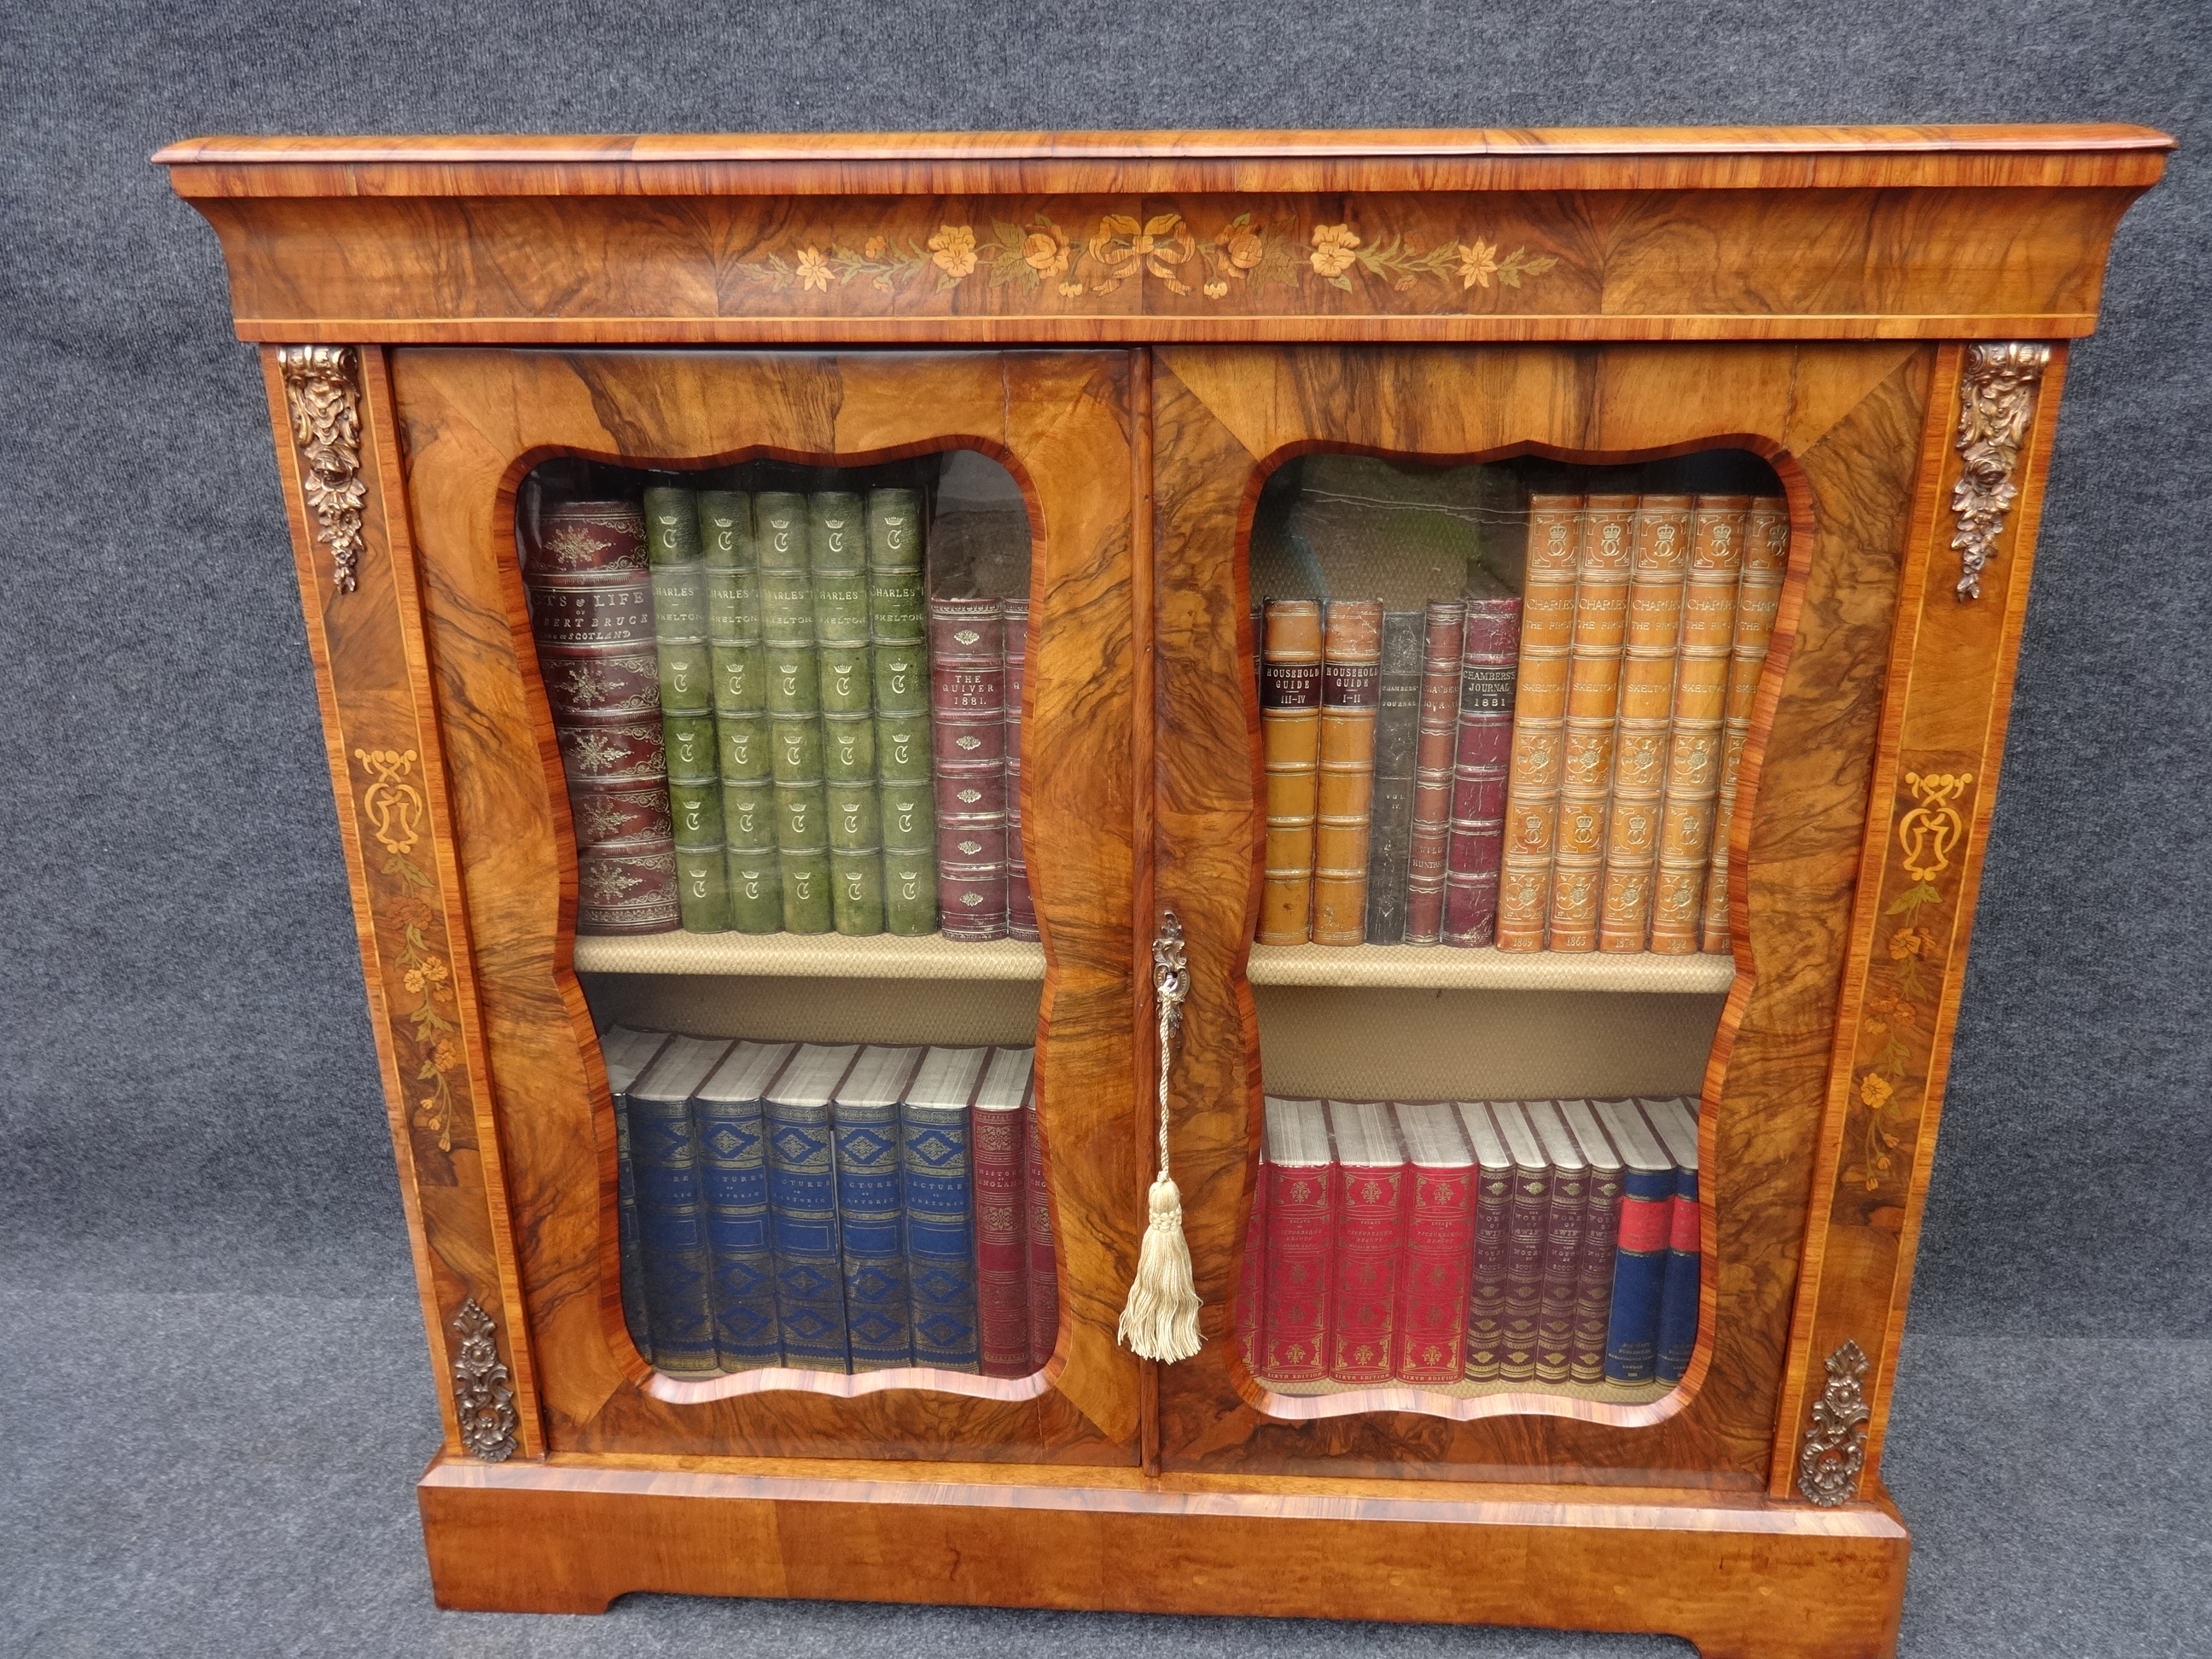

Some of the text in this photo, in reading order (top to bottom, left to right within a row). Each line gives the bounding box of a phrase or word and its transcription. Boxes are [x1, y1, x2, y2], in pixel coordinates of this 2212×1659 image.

[708, 589, 749, 598] HARLES
[763, 590, 804, 600] HARLES
[817, 589, 859, 600] HARLES
[870, 585, 916, 597] CHARLES
[576, 598, 585, 607] &
[594, 591, 644, 608] LIFE
[1527, 599, 1574, 610] CHARLES
[1580, 599, 1627, 610] CHARLES
[1633, 600, 1680, 611] CHARLES
[1742, 600, 1778, 611] CHAR
[591, 614, 648, 628] BRUCE
[1526, 620, 1543, 630] THE
[1578, 620, 1595, 630] THE
[1632, 621, 1649, 630] THE
[1686, 620, 1704, 630] THE
[1740, 622, 1759, 631] THE
[568, 630, 631, 640] SCOTLAND
[1266, 668, 1319, 678] HOUSEHOLD
[1326, 667, 1378, 677] HOUSEHOLD
[1276, 680, 1310, 689] GUIDE
[1336, 678, 1369, 688] GUIDE
[1469, 684, 1510, 692] JOURNAL
[1522, 684, 1564, 692] SKELTON
[1573, 684, 1615, 692] SKELTON
[1475, 698, 1505, 707] 1881
[722, 1173, 763, 1182] TURES
[782, 1179, 830, 1188] CTURES
